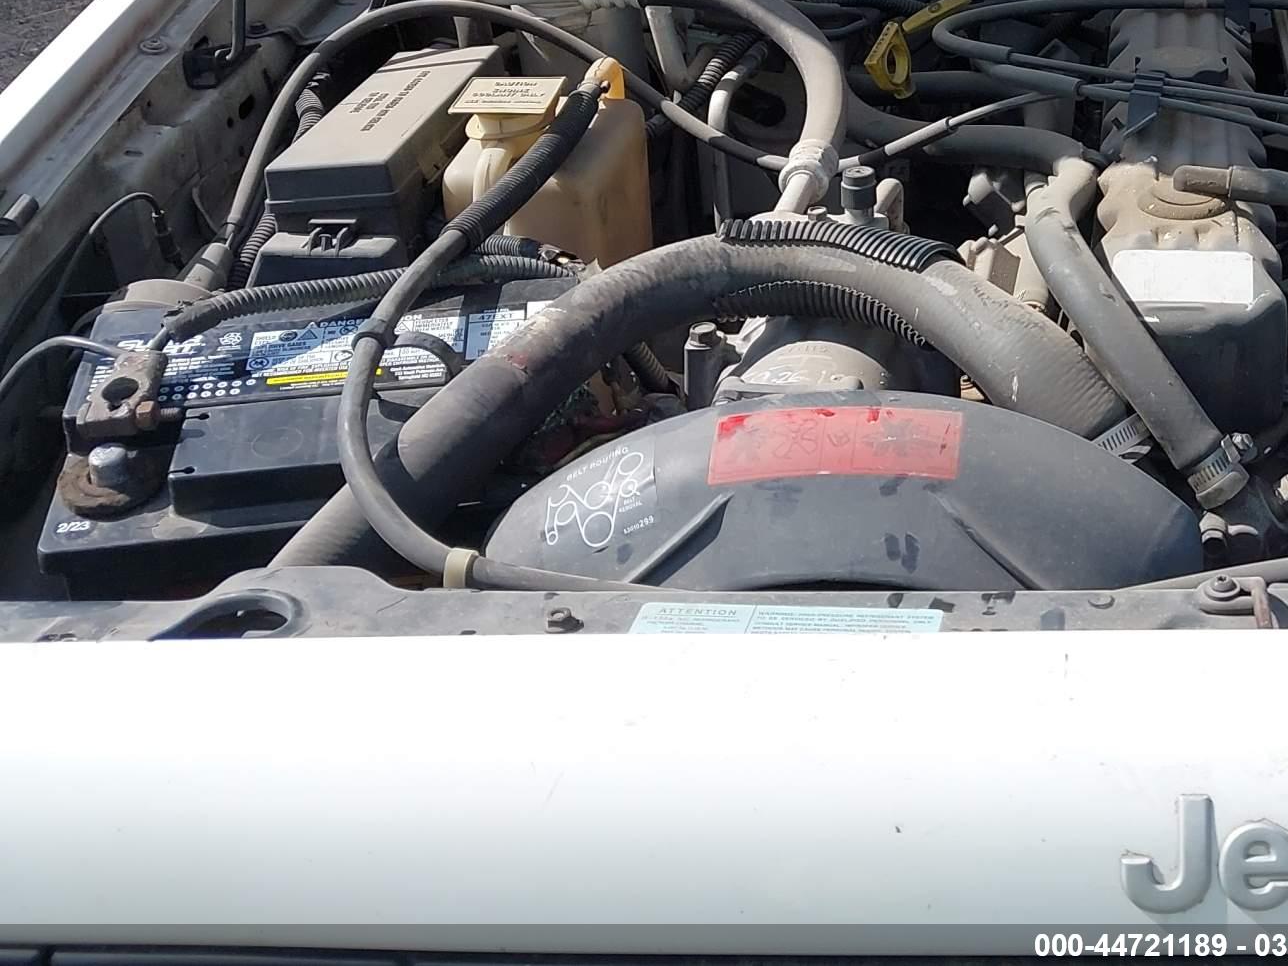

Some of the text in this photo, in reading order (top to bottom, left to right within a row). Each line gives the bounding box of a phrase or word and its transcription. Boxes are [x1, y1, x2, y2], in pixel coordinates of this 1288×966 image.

[566, 446, 629, 482] BELT ROUTING
[56, 520, 91, 534] 2/23
[659, 607, 738, 616] ATTENTION
